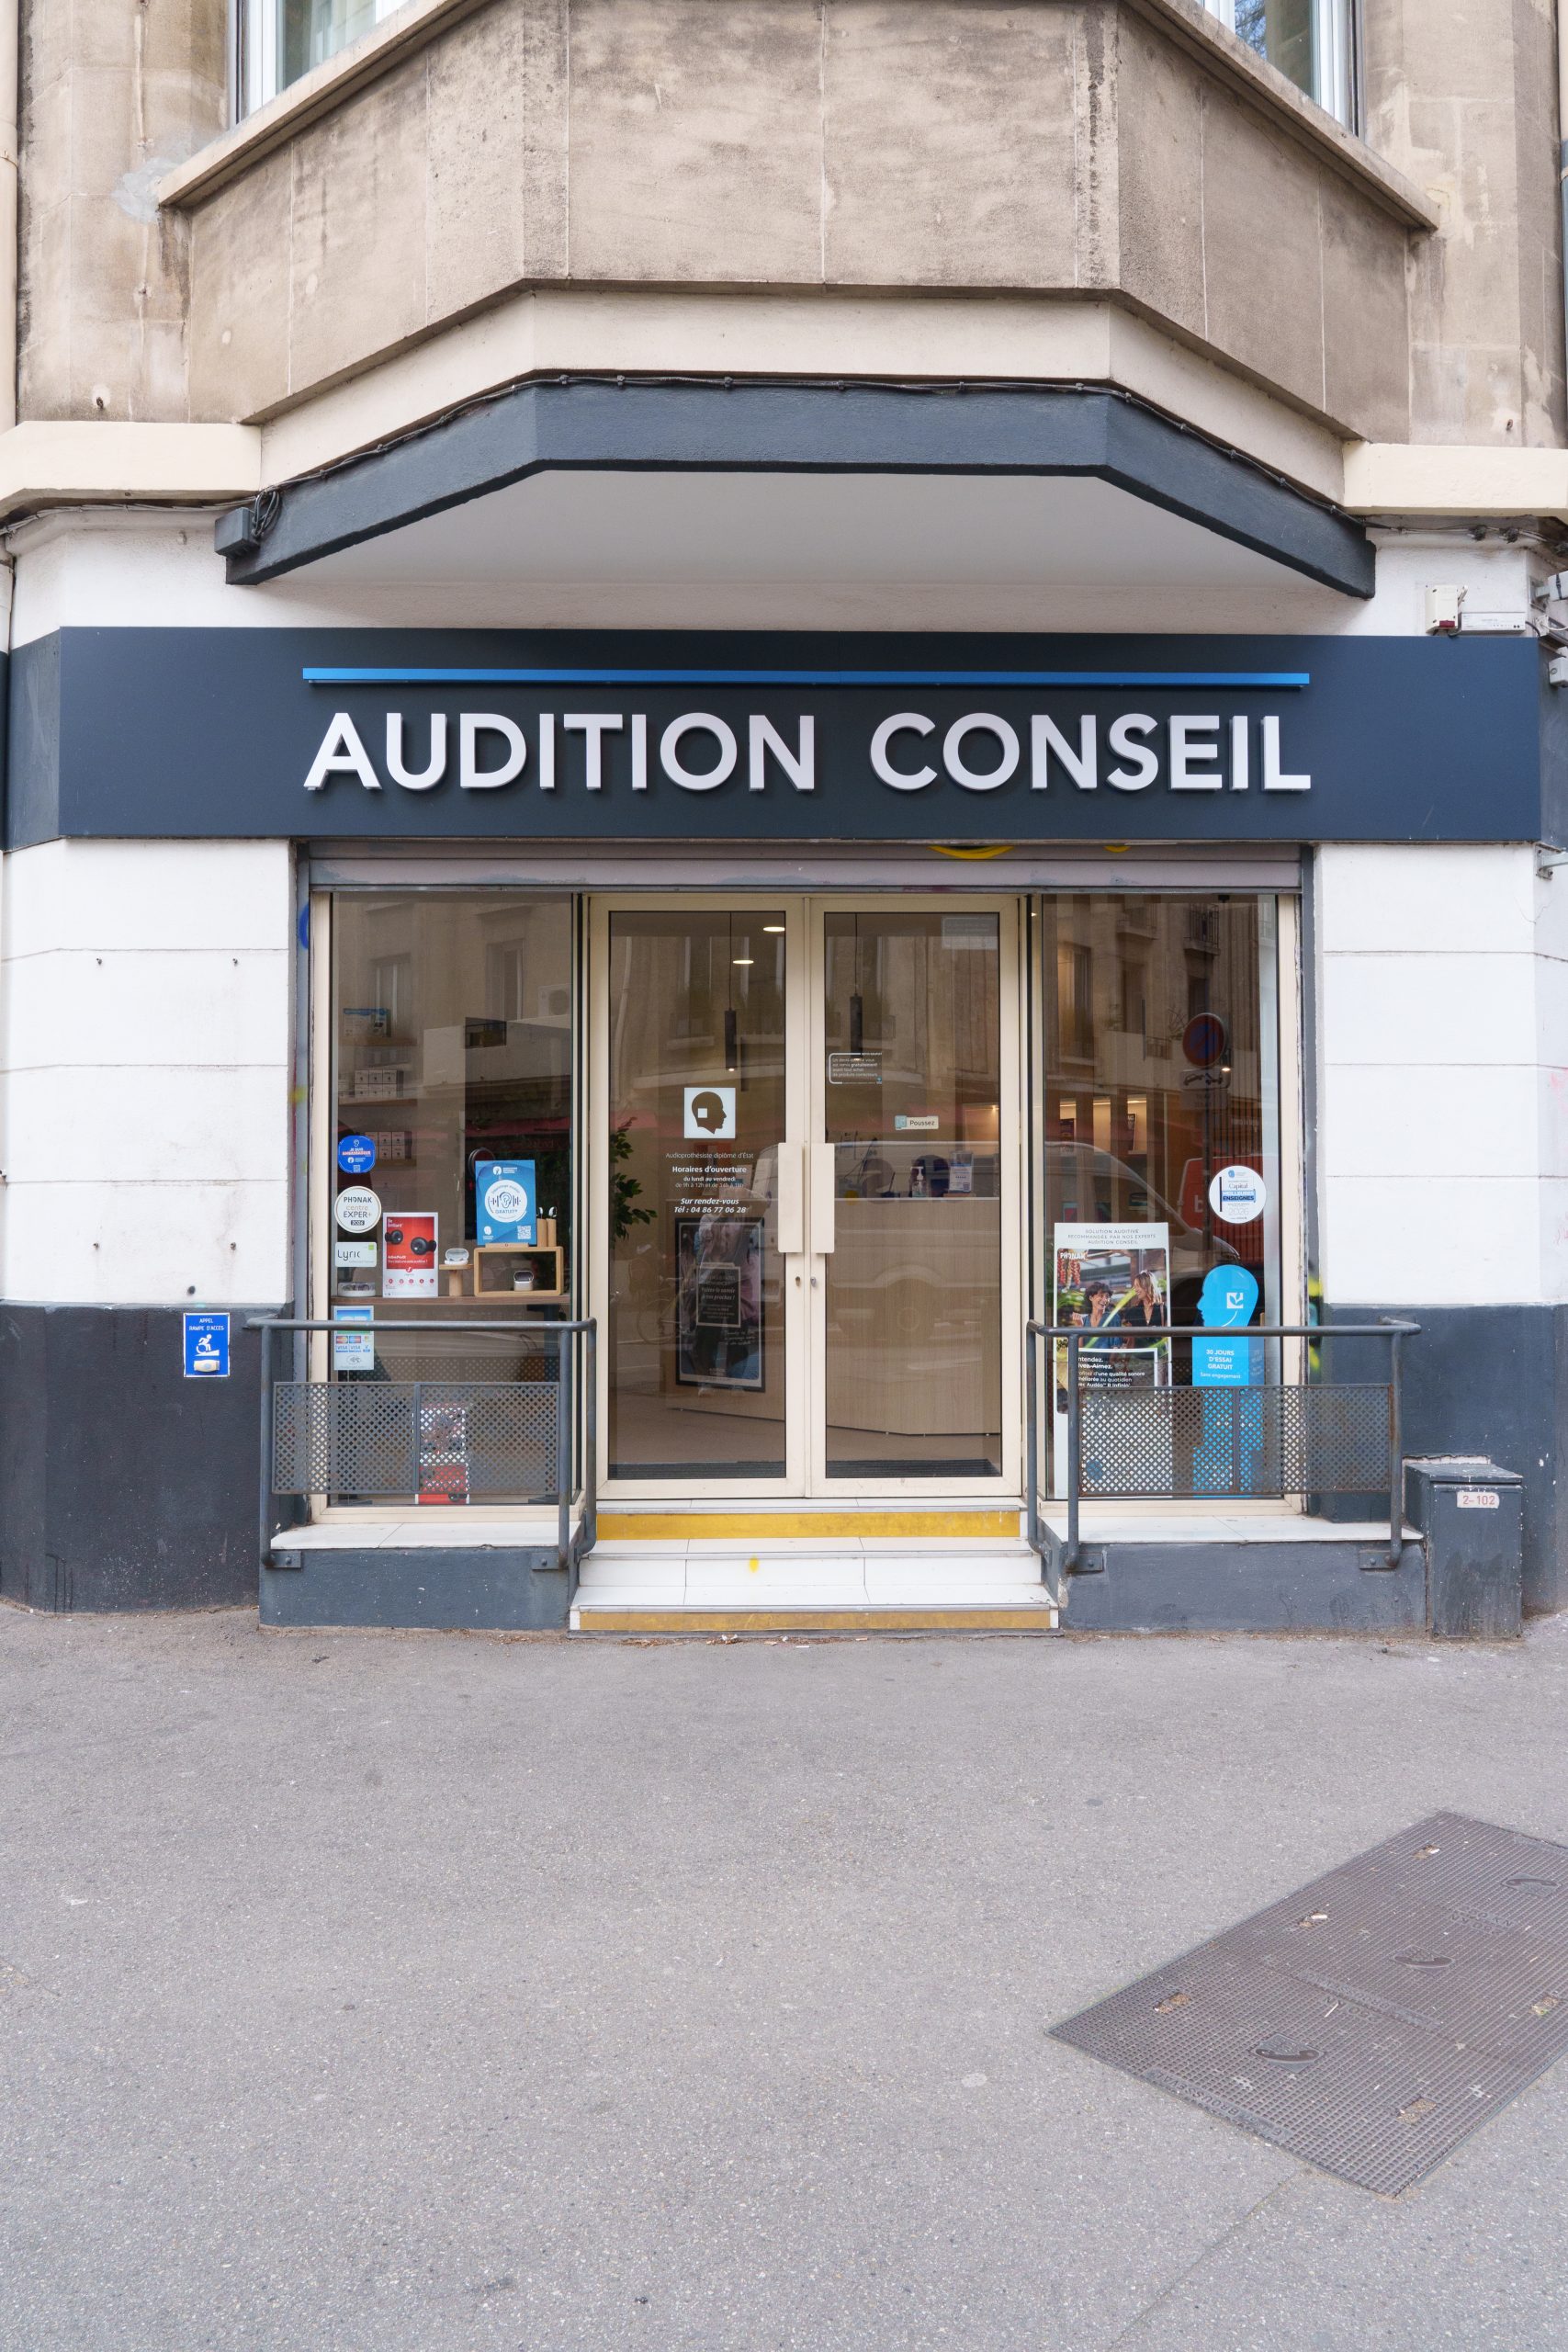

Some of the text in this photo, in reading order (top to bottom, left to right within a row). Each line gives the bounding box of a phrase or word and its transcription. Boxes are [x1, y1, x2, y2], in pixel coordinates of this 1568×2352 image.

[303, 712, 1312, 791] AUDITION CONSEIL
[705, 1165, 747, 1173] d'ouverture
[1462, 1495, 1495, 1505] 2-102
